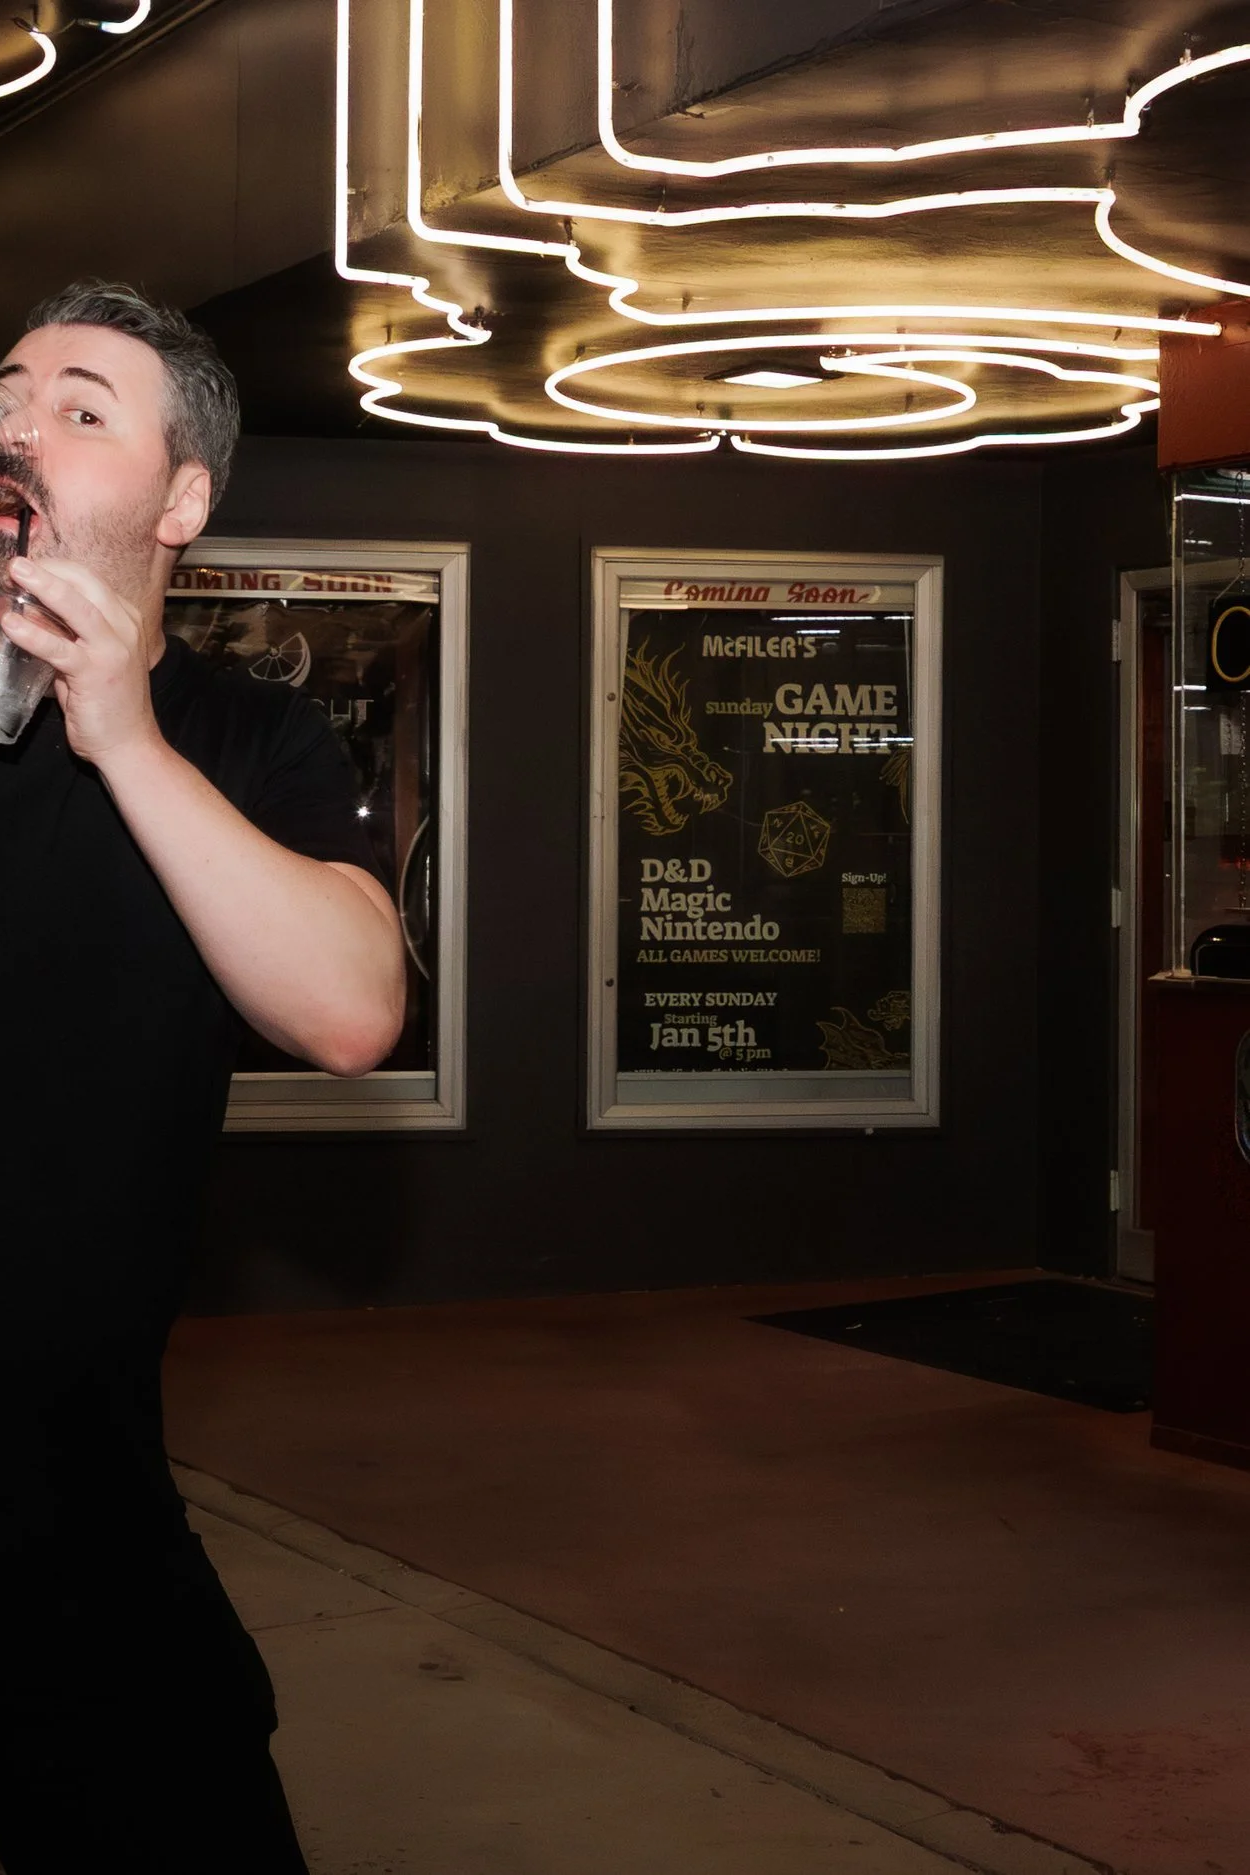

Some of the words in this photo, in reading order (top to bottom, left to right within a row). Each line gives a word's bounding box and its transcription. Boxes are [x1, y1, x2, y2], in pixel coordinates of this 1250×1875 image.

[170, 573, 282, 591] OMING
[786, 581, 871, 604] Soon
[705, 697, 774, 719] sunday
[774, 683, 898, 717] GAME
[762, 722, 898, 755] NIGHT
[640, 858, 712, 883] D&D
[841, 872, 887, 884] Sign-Up!
[640, 885, 732, 919] Magic
[640, 913, 780, 942] Nintendo
[636, 949, 668, 963] ALL
[669, 948, 729, 963] GAMES
[730, 948, 822, 964] WELCOME!
[644, 992, 703, 1007] EVERY
[705, 991, 778, 1007] SUNDAY
[663, 1012, 718, 1026] Starting
[649, 1022, 702, 1051] Jan
[706, 1019, 758, 1052] 5th
[718, 1047, 733, 1060] @
